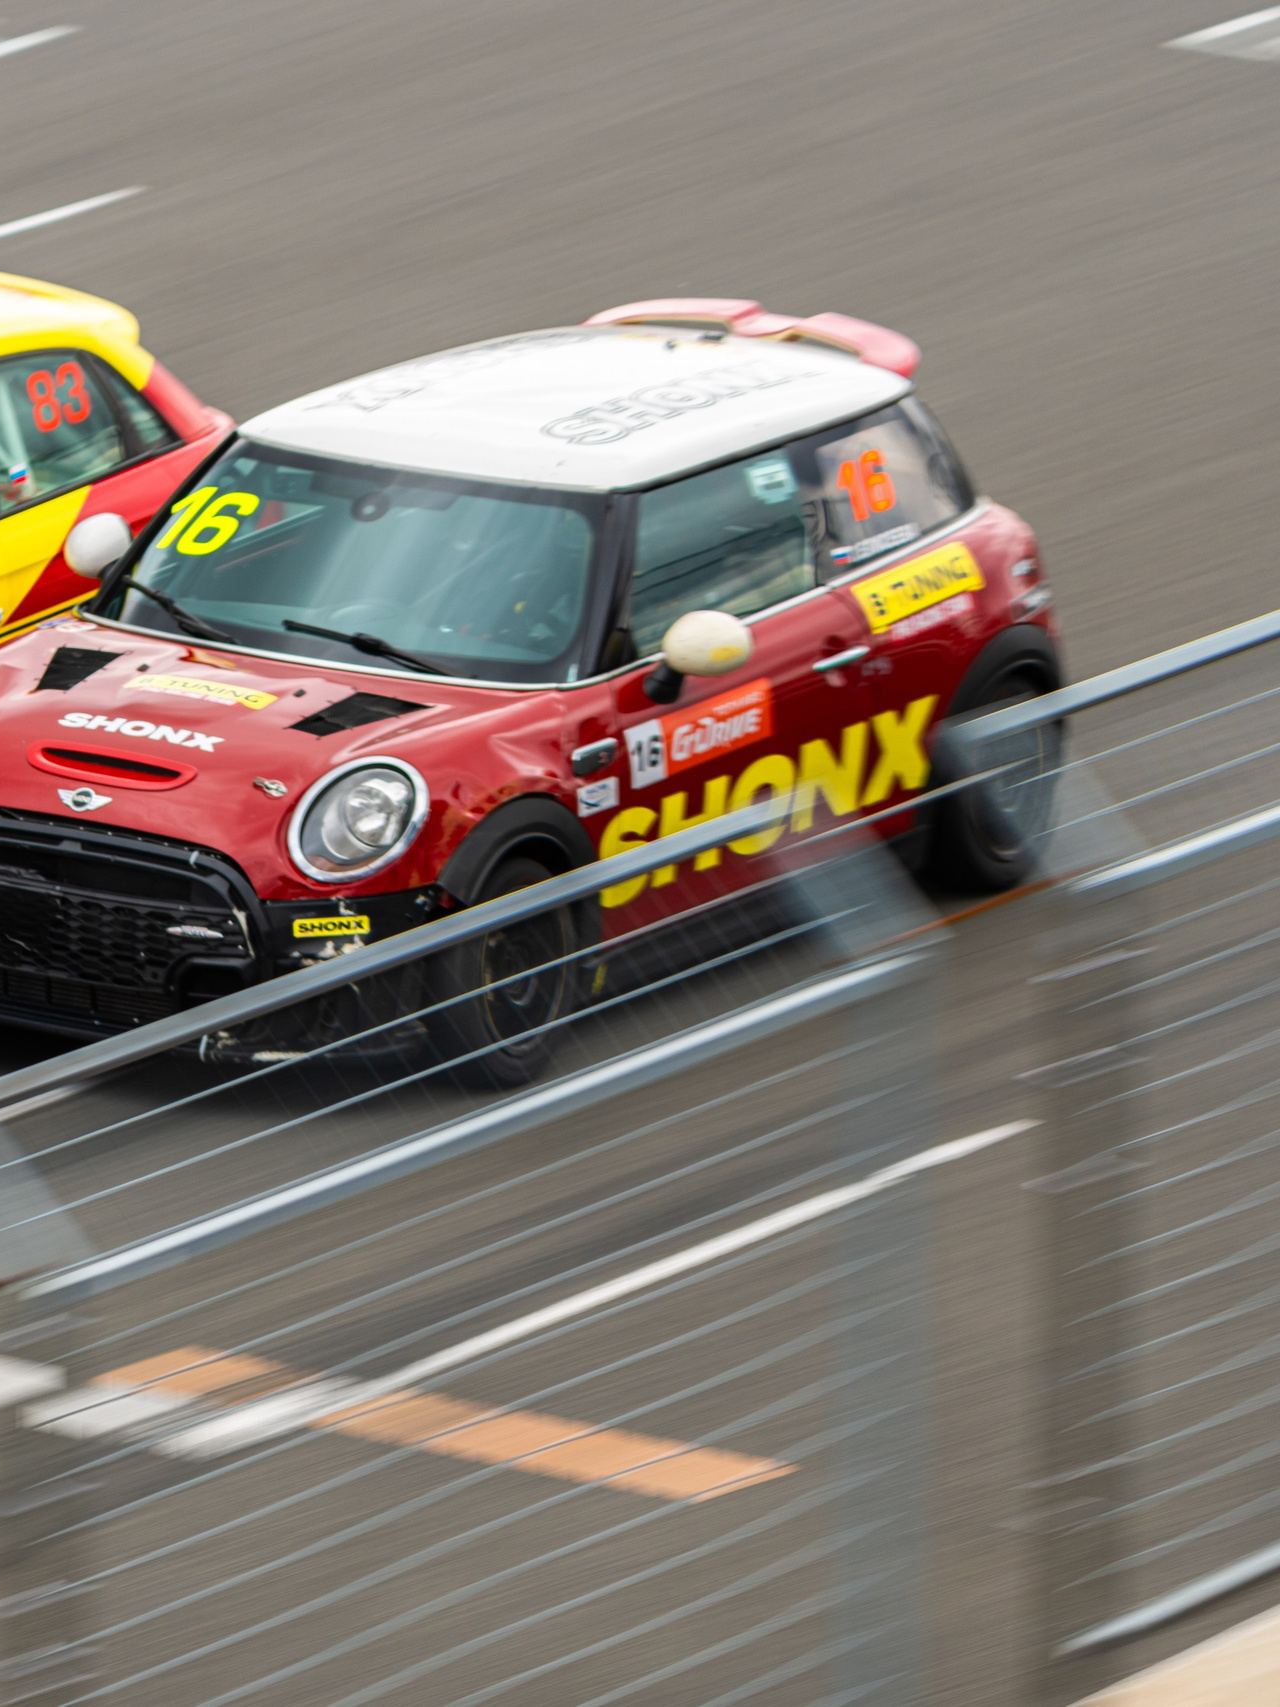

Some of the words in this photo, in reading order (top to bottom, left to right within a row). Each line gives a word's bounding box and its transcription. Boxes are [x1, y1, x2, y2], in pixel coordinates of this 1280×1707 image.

[27, 362, 92, 433] 83
[837, 448, 896, 522] 16
[156, 486, 260, 556] 16
[58, 712, 225, 752] SHONX
[631, 735, 662, 772] 16
[600, 695, 940, 909] SHONX
[298, 918, 364, 934] SHONX
